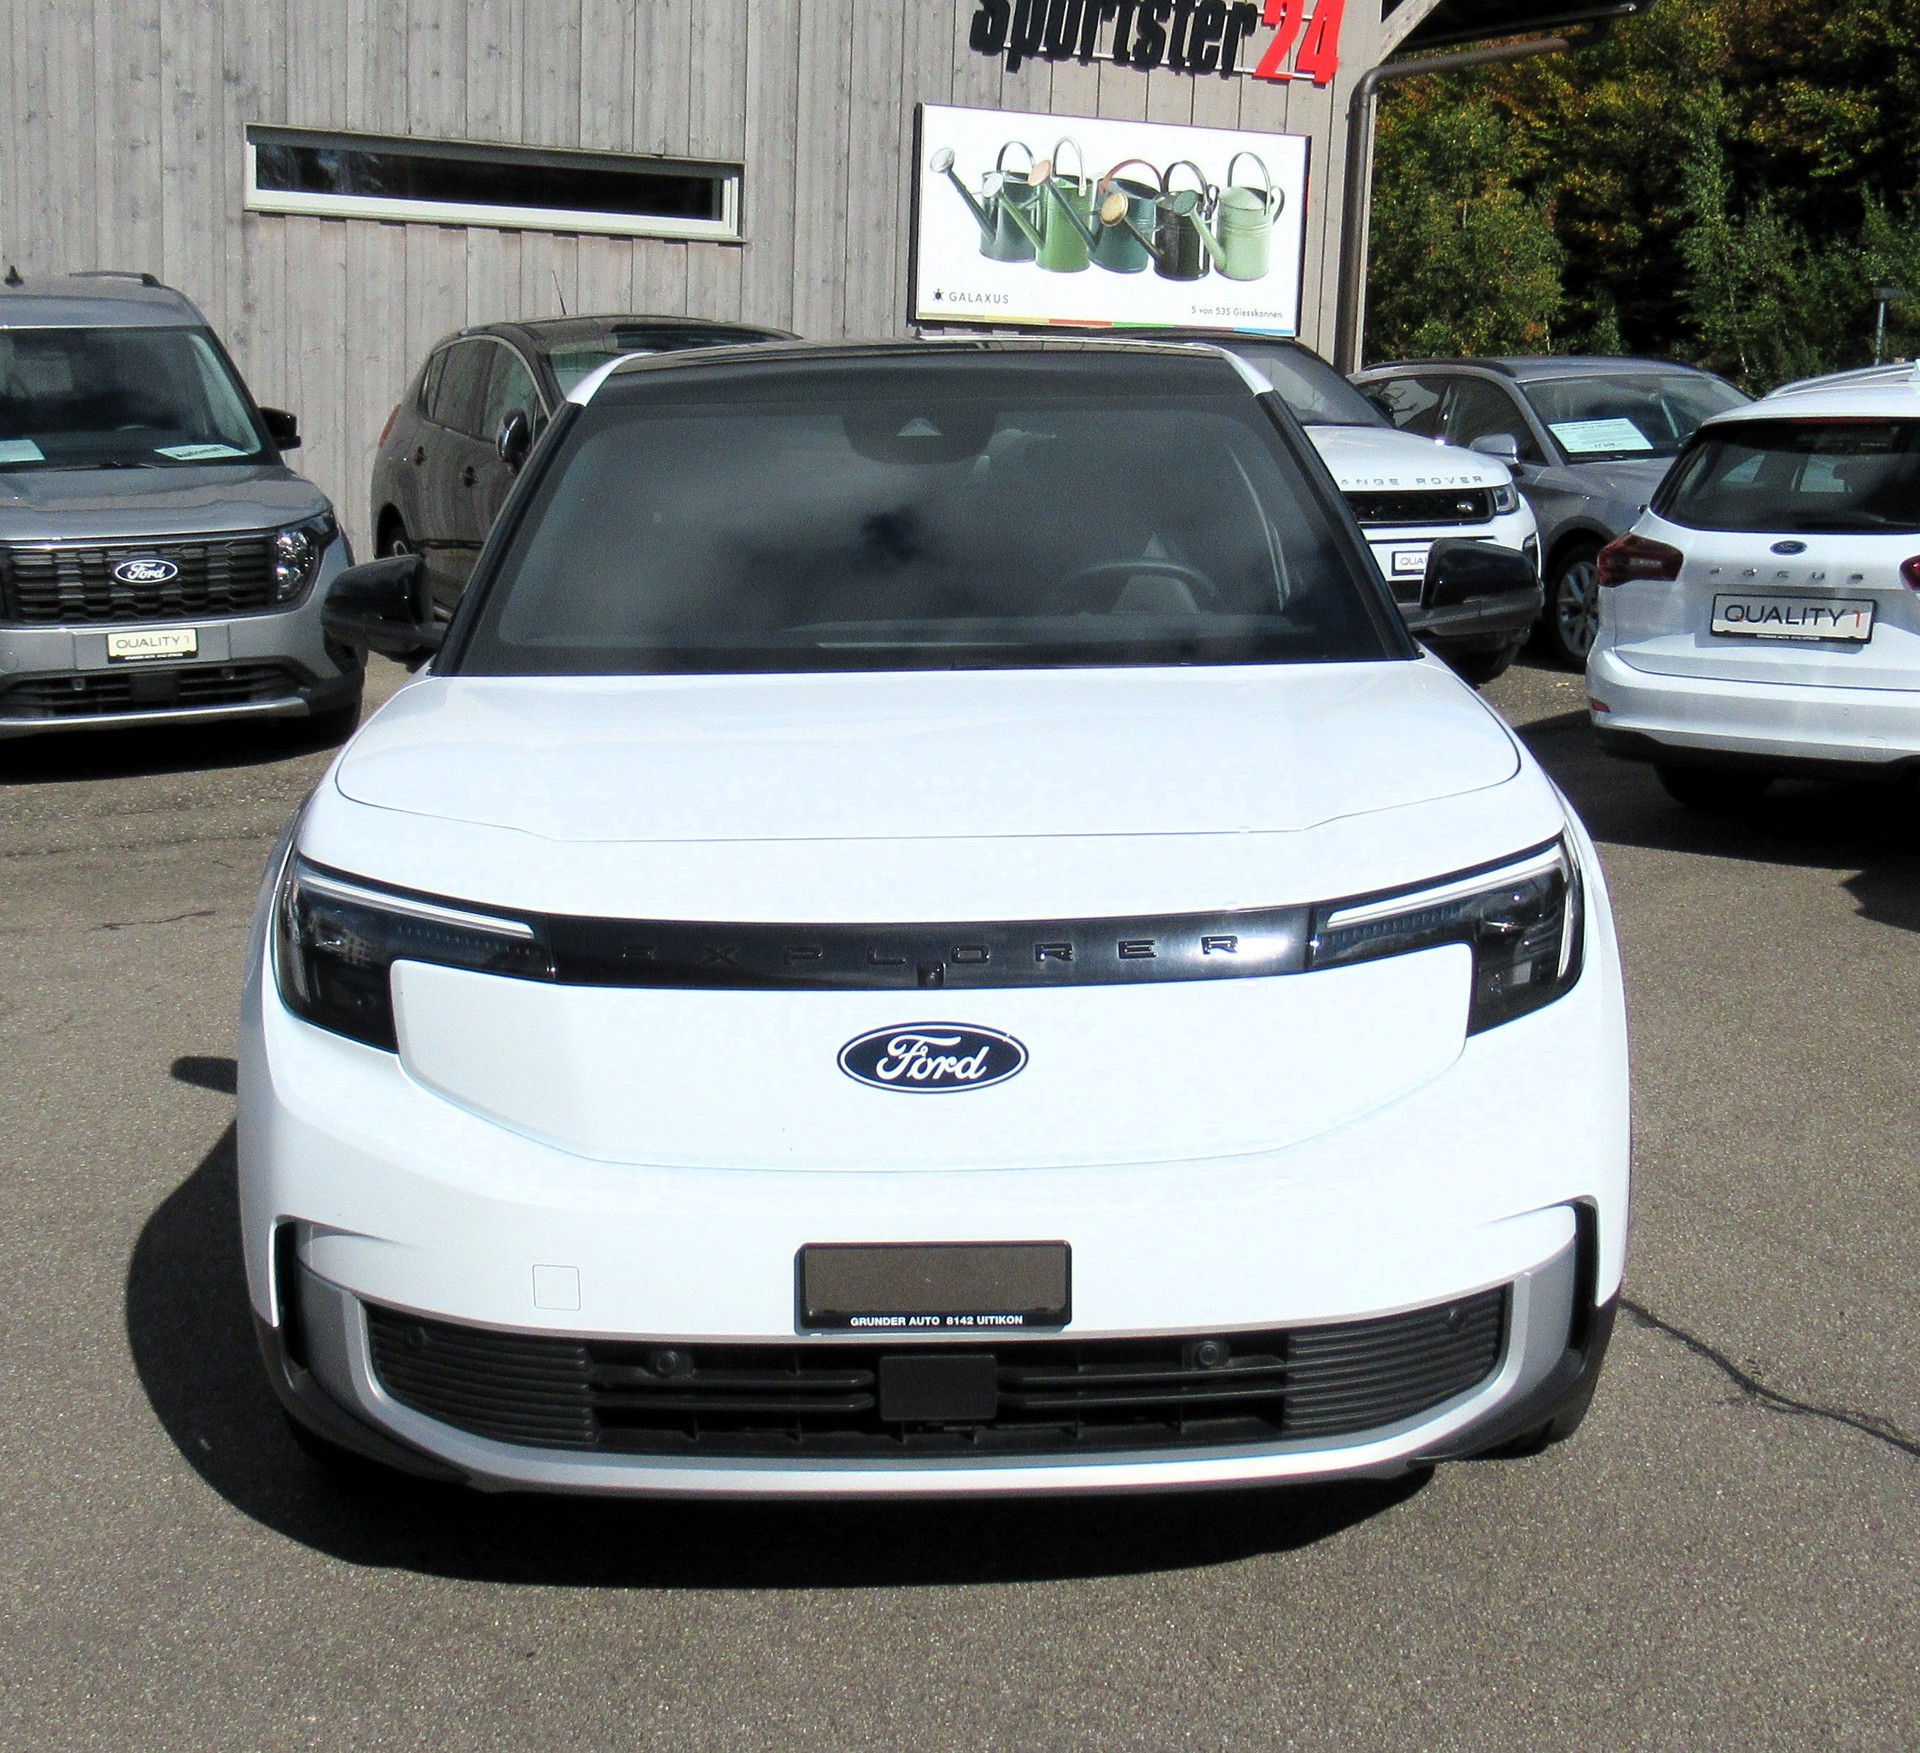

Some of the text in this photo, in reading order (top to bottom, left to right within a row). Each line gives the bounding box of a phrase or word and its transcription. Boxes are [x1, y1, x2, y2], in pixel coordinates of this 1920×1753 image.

[949, 291, 1009, 304] GALAXUS
[1191, 305, 1197, 314] 5
[1216, 307, 1231, 316] 535
[1233, 308, 1283, 318] Giesskannen
[1341, 475, 1484, 486] ANGE ROVER
[127, 563, 166, 579] Ford
[1725, 604, 1846, 627] QUALITY
[116, 636, 180, 649] QUALITY
[622, 935, 1237, 966] EXPLORER
[876, 1034, 990, 1080] Ford
[850, 1315, 1023, 1327] GRUNDER AUTO 8142 UITIKON
